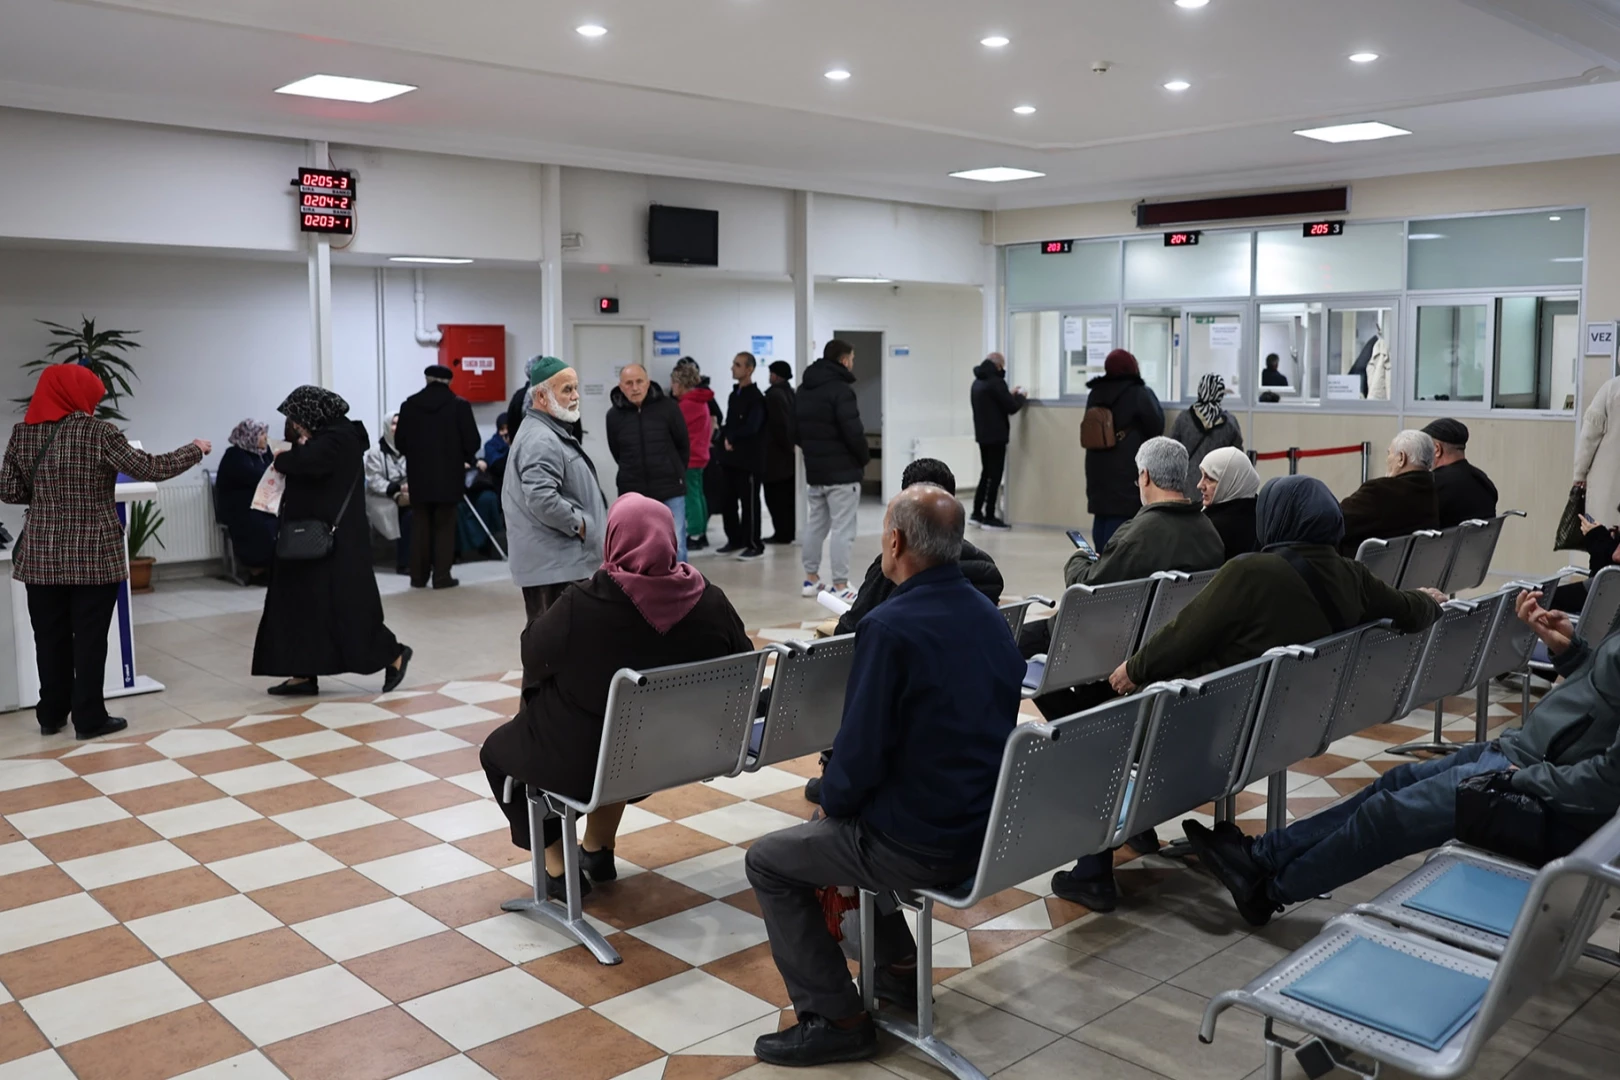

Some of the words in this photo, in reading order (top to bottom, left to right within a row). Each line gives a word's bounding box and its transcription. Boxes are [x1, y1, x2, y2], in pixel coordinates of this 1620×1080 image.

[303, 174, 347, 188] 0205-3
[304, 195, 348, 208] 0204-2
[1310, 223, 1329, 235] 205
[1333, 223, 1340, 233] 3
[1170, 234, 1187, 244] 204
[1190, 235, 1196, 243] 2
[1047, 243, 1061, 252] 203
[1063, 243, 1068, 251] 1
[1591, 332, 1612, 342] VEZ
